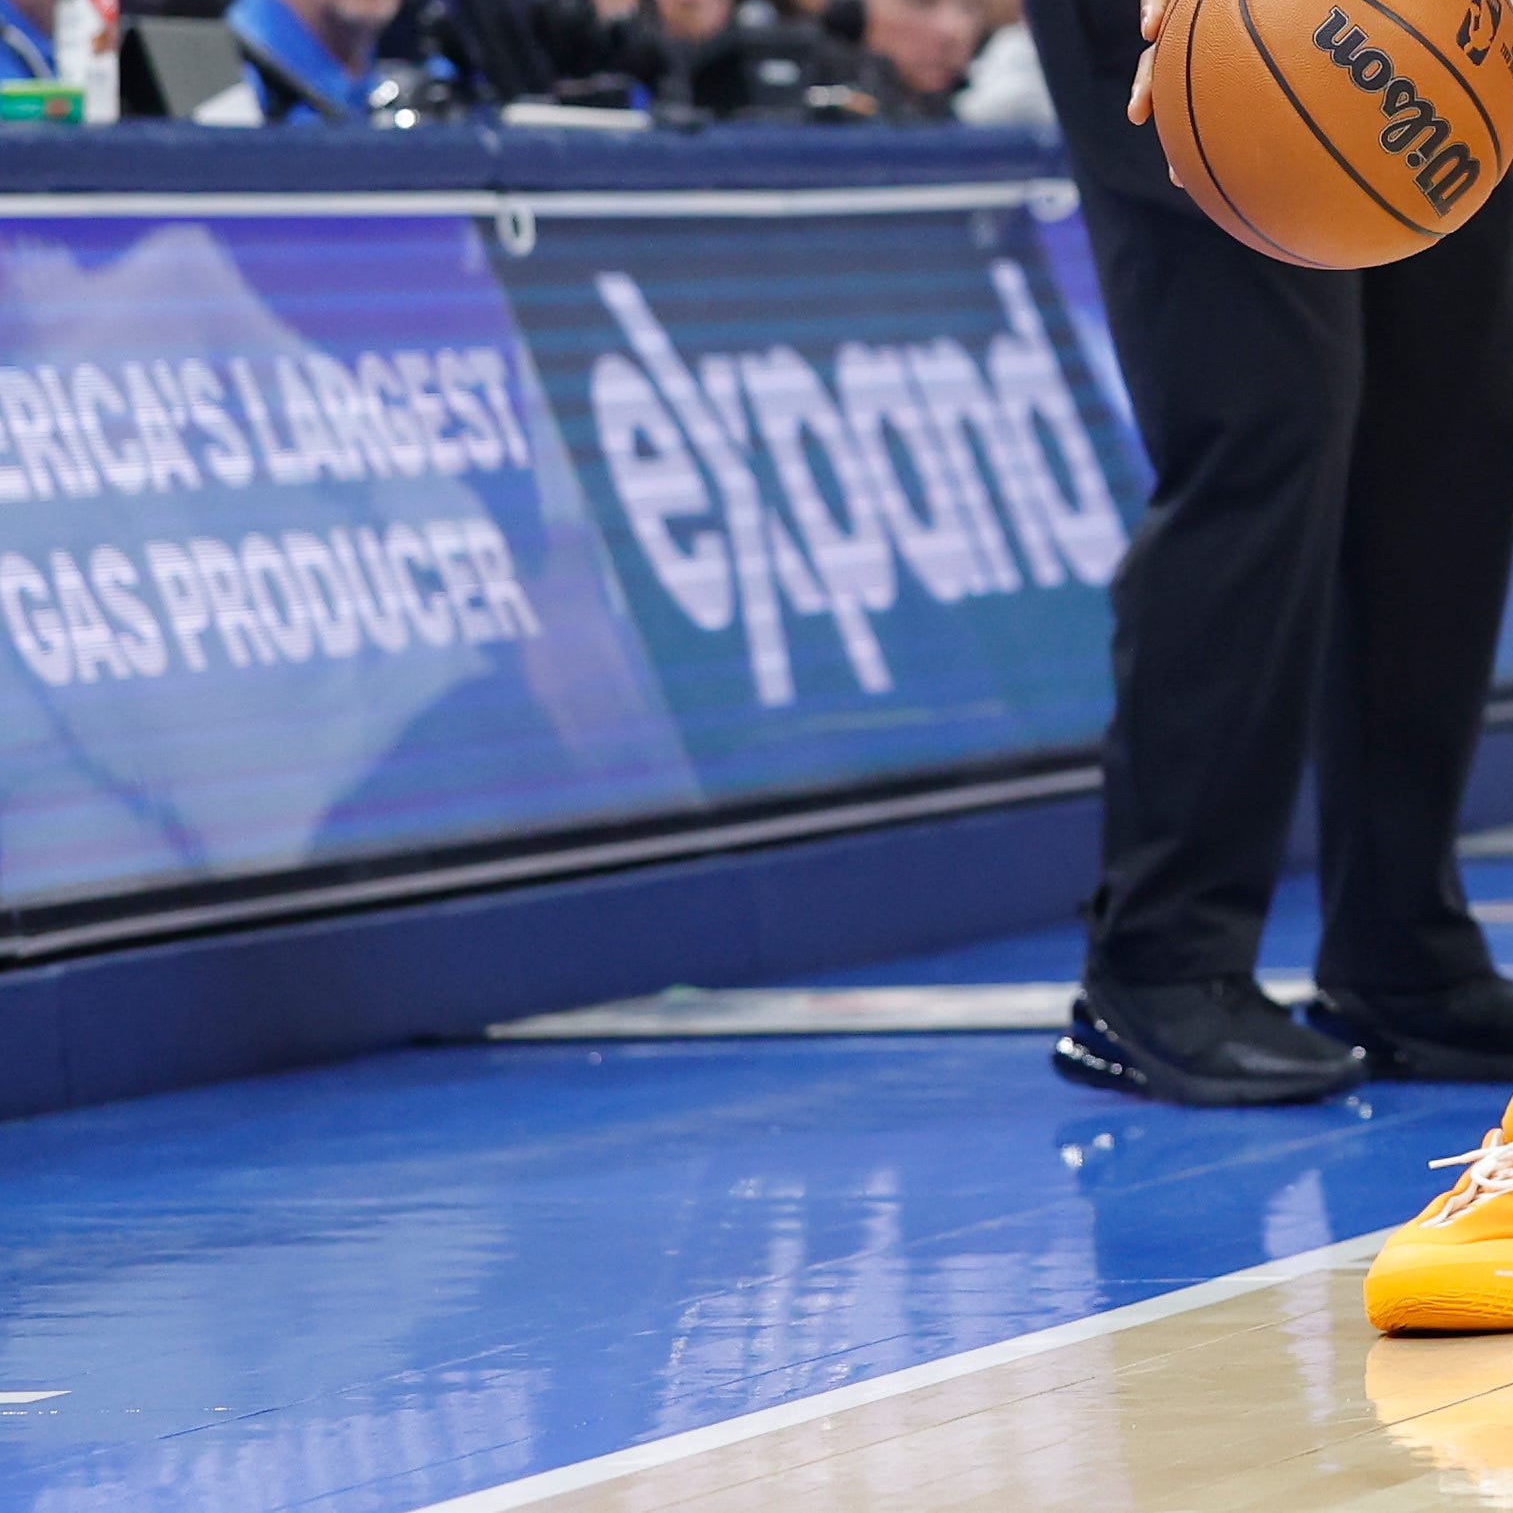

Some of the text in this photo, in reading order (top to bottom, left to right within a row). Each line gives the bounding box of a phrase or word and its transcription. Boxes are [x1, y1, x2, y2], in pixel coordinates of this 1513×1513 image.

[1312, 5, 1482, 218] Wilson
[228, 347, 530, 486] LARGEST
[589, 256, 1134, 709] expand
[0, 517, 542, 688] GAS PRODUCER
